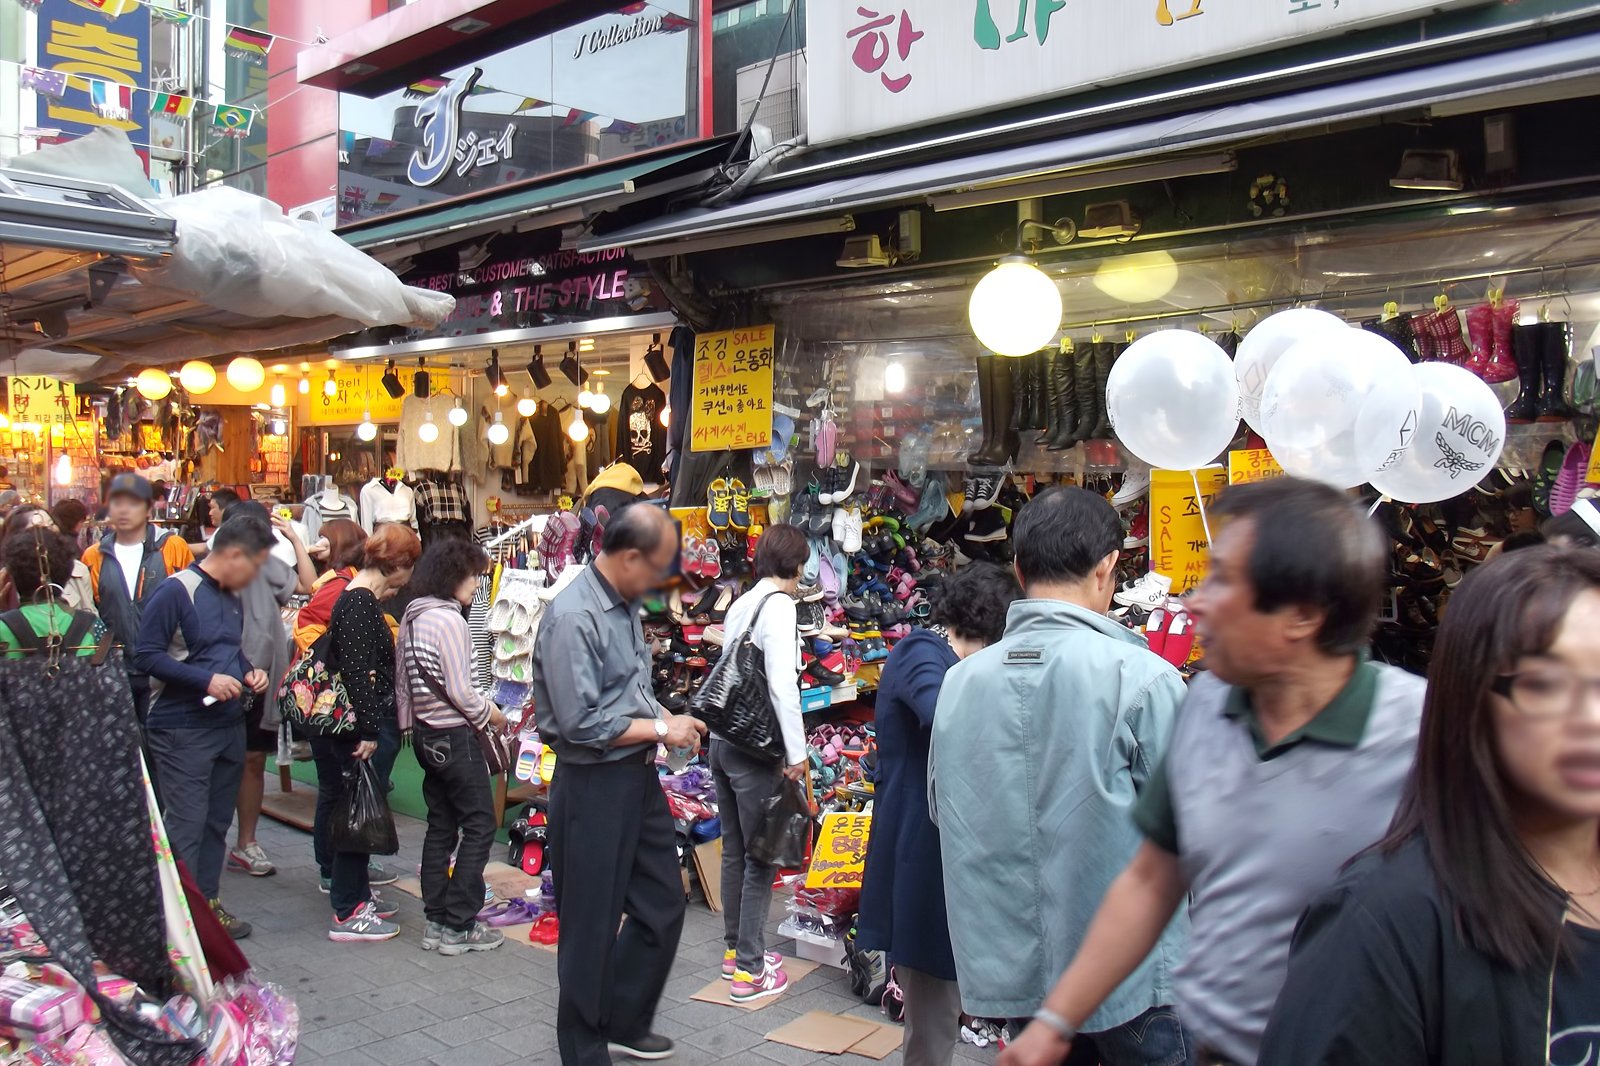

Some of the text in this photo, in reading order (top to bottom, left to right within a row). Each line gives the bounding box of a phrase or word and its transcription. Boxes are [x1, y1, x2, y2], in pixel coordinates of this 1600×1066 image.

[572, 14, 663, 59] J Collection
[454, 123, 517, 178] ジェイ
[428, 272, 454, 291] BEST
[474, 257, 536, 284] CUSTOMER
[539, 246, 626, 272] SATISFACTION
[490, 291, 503, 317] &
[514, 282, 553, 313] THE
[558, 270, 628, 311] STYLE
[697, 338, 728, 362] 조깅
[732, 328, 767, 346] SALE
[732, 347, 773, 373] 운동화
[1442, 406, 1500, 458] MCM
[1160, 505, 1173, 571] SALE
